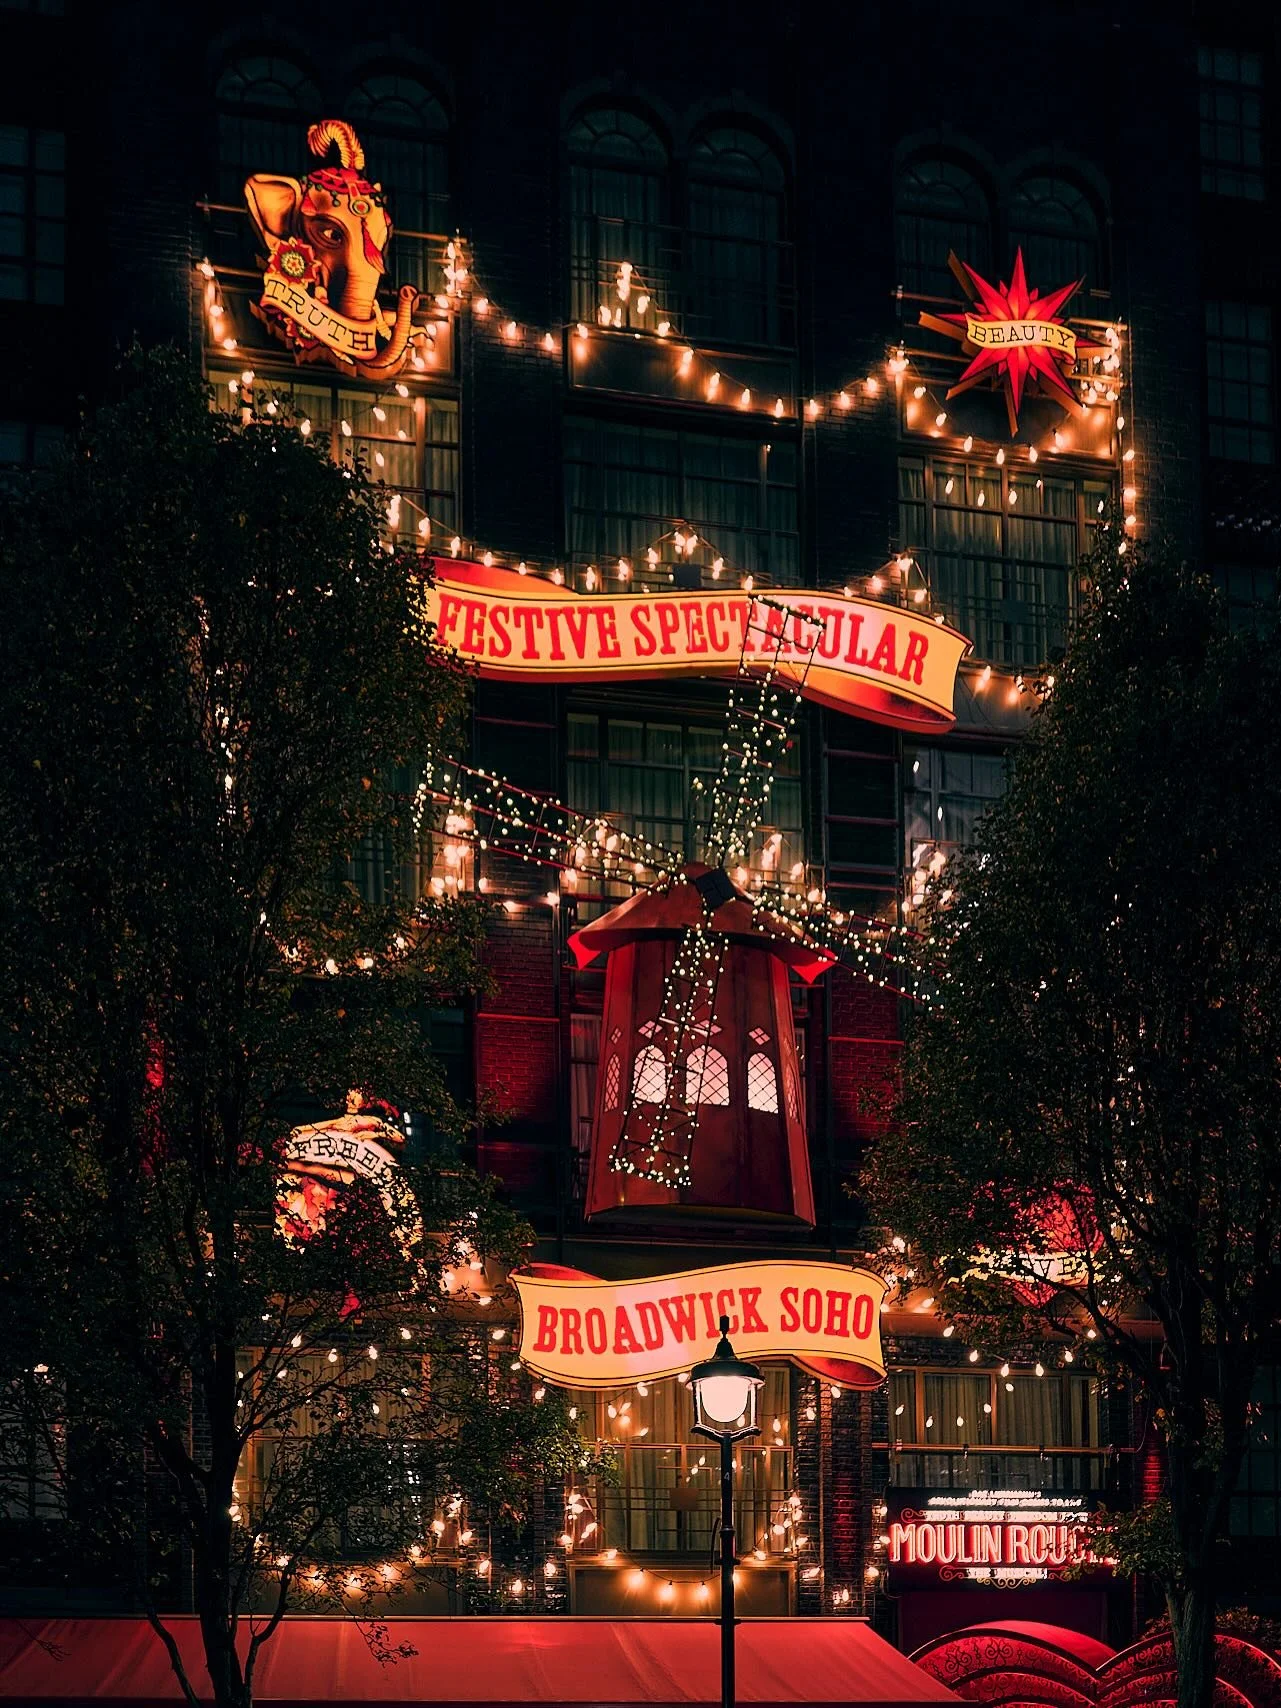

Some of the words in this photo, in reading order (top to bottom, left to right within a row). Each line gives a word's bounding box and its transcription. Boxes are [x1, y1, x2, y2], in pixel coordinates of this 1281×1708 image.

[264, 279, 374, 352] TRUTH
[970, 322, 1074, 348] BEAUTY
[437, 592, 622, 661] FESTIVE
[630, 600, 931, 685] SPECTACULAR
[533, 1286, 768, 1355] BROADWICK
[780, 1286, 874, 1340] SOHO
[889, 1523, 1002, 1563] MOULIN
